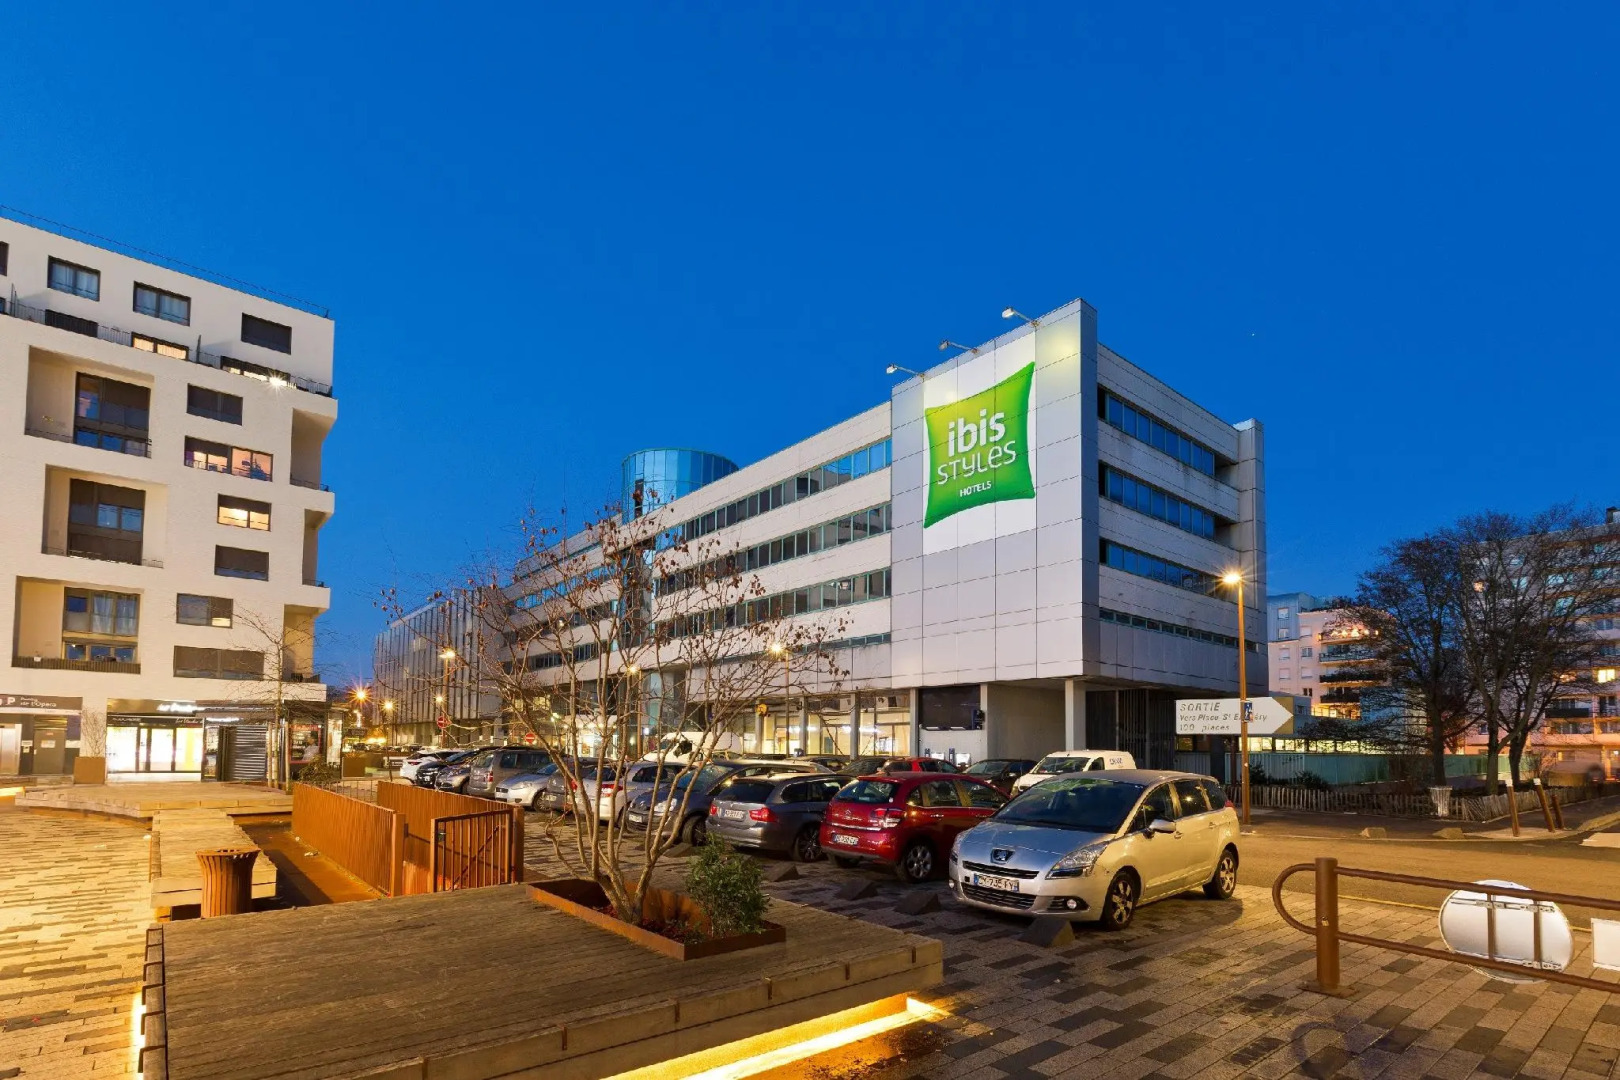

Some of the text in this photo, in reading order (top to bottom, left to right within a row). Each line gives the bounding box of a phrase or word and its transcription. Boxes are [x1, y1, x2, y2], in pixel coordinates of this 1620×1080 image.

[948, 408, 1006, 457] ibis
[959, 480, 992, 498] HOTELS
[1179, 702, 1221, 712] SORTIE
[1233, 712, 1268, 722] Eéry
[1179, 723, 1230, 732] 100 places
